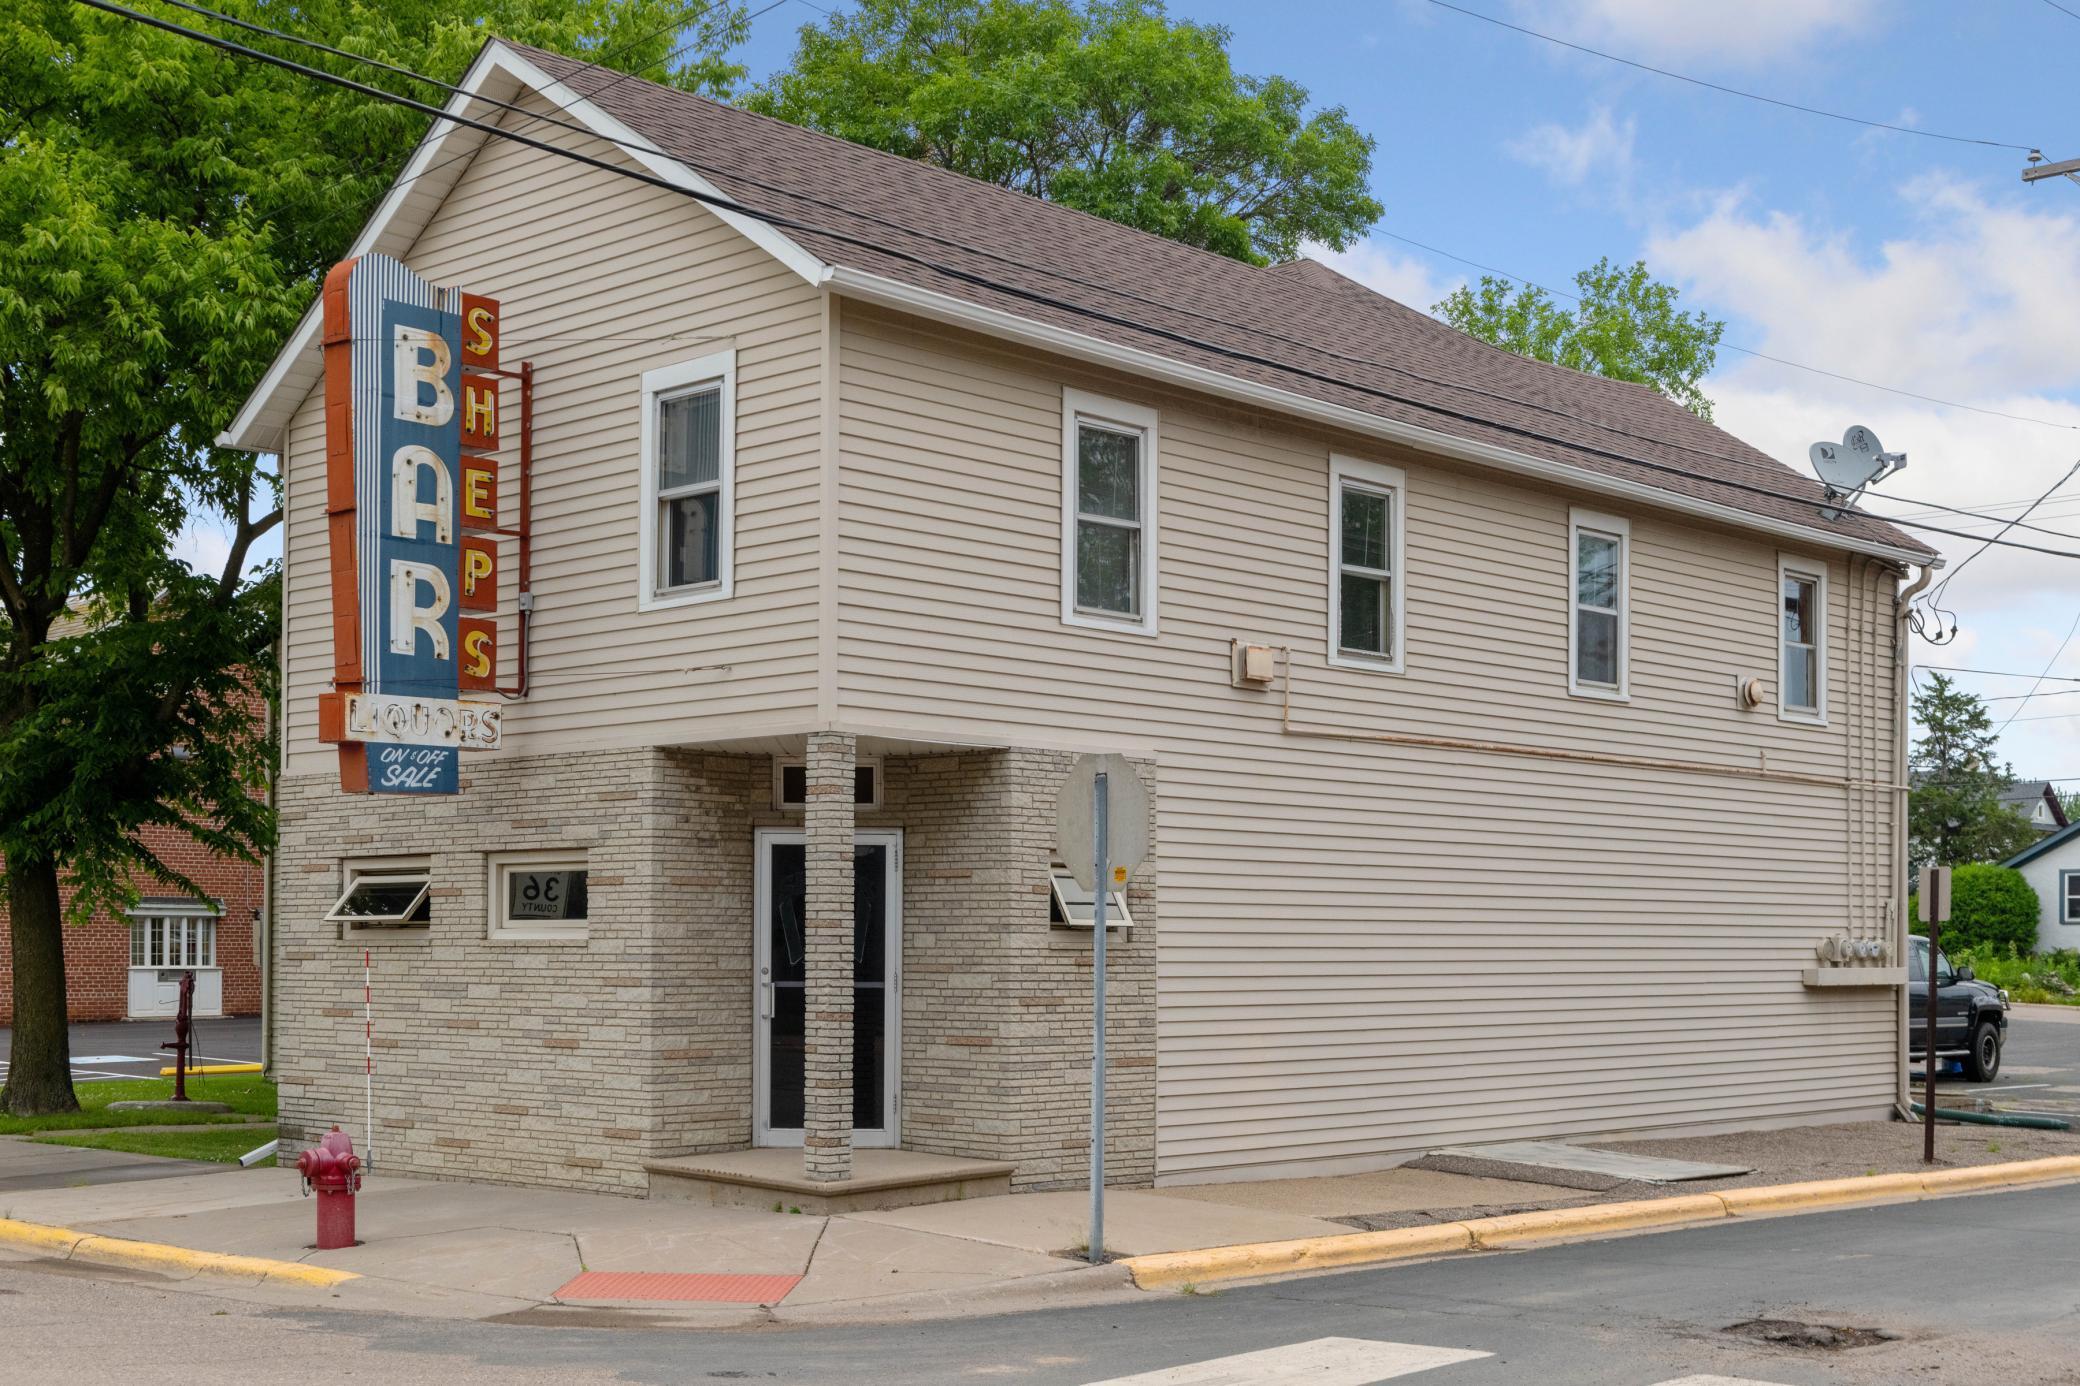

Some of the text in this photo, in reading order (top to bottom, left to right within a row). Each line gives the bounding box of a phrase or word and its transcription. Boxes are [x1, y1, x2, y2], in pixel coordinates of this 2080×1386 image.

[390, 323, 455, 661] BAR
[464, 307, 495, 678] SHEPS
[349, 699, 500, 743] LIQUORS
[380, 747, 410, 763] ON
[416, 749, 449, 765] OFF
[381, 764, 442, 788] SALE
